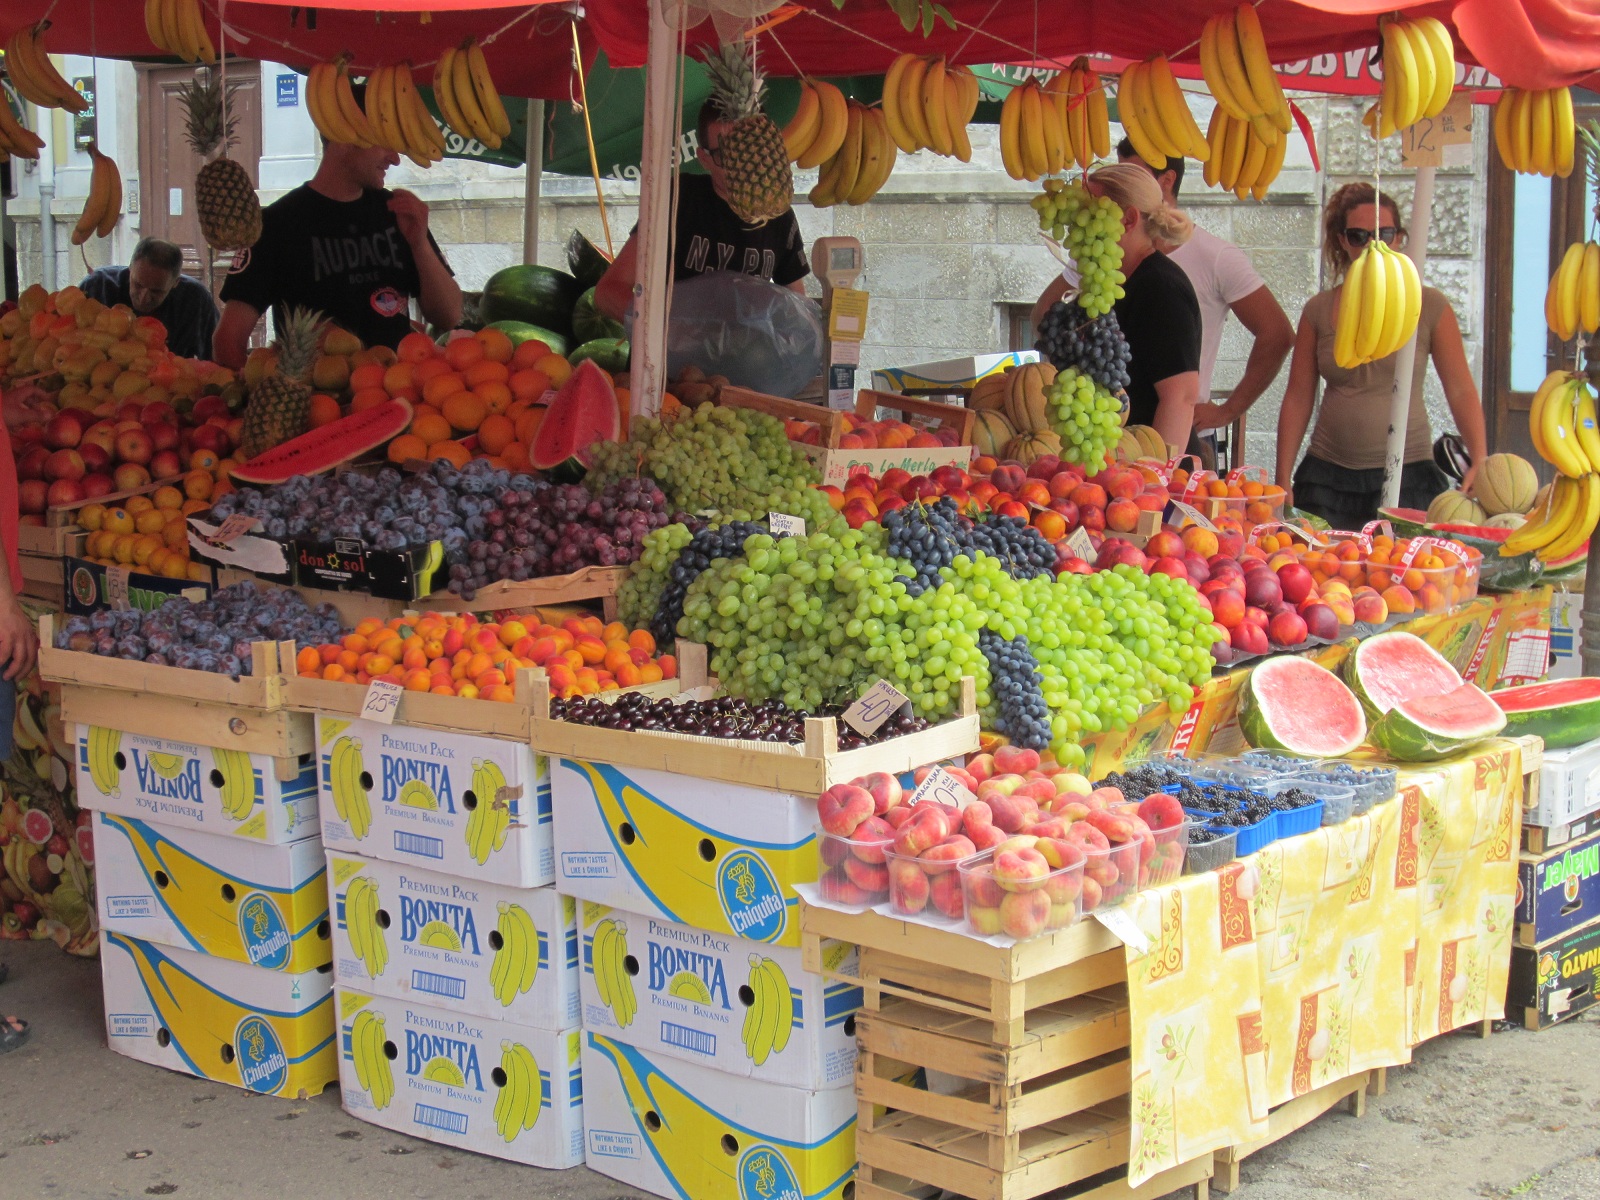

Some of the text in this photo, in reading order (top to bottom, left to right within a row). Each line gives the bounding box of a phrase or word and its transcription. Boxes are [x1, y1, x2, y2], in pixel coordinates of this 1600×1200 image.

[1410, 117, 1435, 151] 12
[311, 226, 403, 281] AUDACE
[901, 457, 936, 473] Merla
[300, 549, 365, 572] don sol
[365, 691, 390, 712] 25
[857, 693, 890, 722] 40
[132, 736, 198, 755] PREMIUM BANANAS
[381, 734, 455, 759] PREMIUM PACK
[131, 748, 204, 803] BONITA
[381, 754, 457, 814] BONITA
[911, 767, 941, 804] PARAGVAJKA
[136, 797, 204, 821] PREMIUM PACK
[385, 805, 454, 828] PREMIUM BANANAS
[571, 866, 581, 874] LIKE
[1543, 843, 1600, 892] Mayer
[399, 875, 479, 902] PREMIUM PACK
[399, 895, 482, 956] BONITA
[732, 892, 783, 933] Chiquita
[250, 929, 289, 963] Chiquita
[648, 920, 730, 953] PREMIUM PACK
[403, 945, 479, 968] PREMIUM BANANAS
[647, 941, 732, 1011] BONITA
[651, 994, 730, 1024] PREMIUM BANANAS
[405, 1010, 483, 1039] PREMIUM PACK
[244, 1052, 285, 1086] Chiquita
[405, 1029, 485, 1092] BONITA
[408, 1078, 482, 1104] PREMIUM BANANAS
